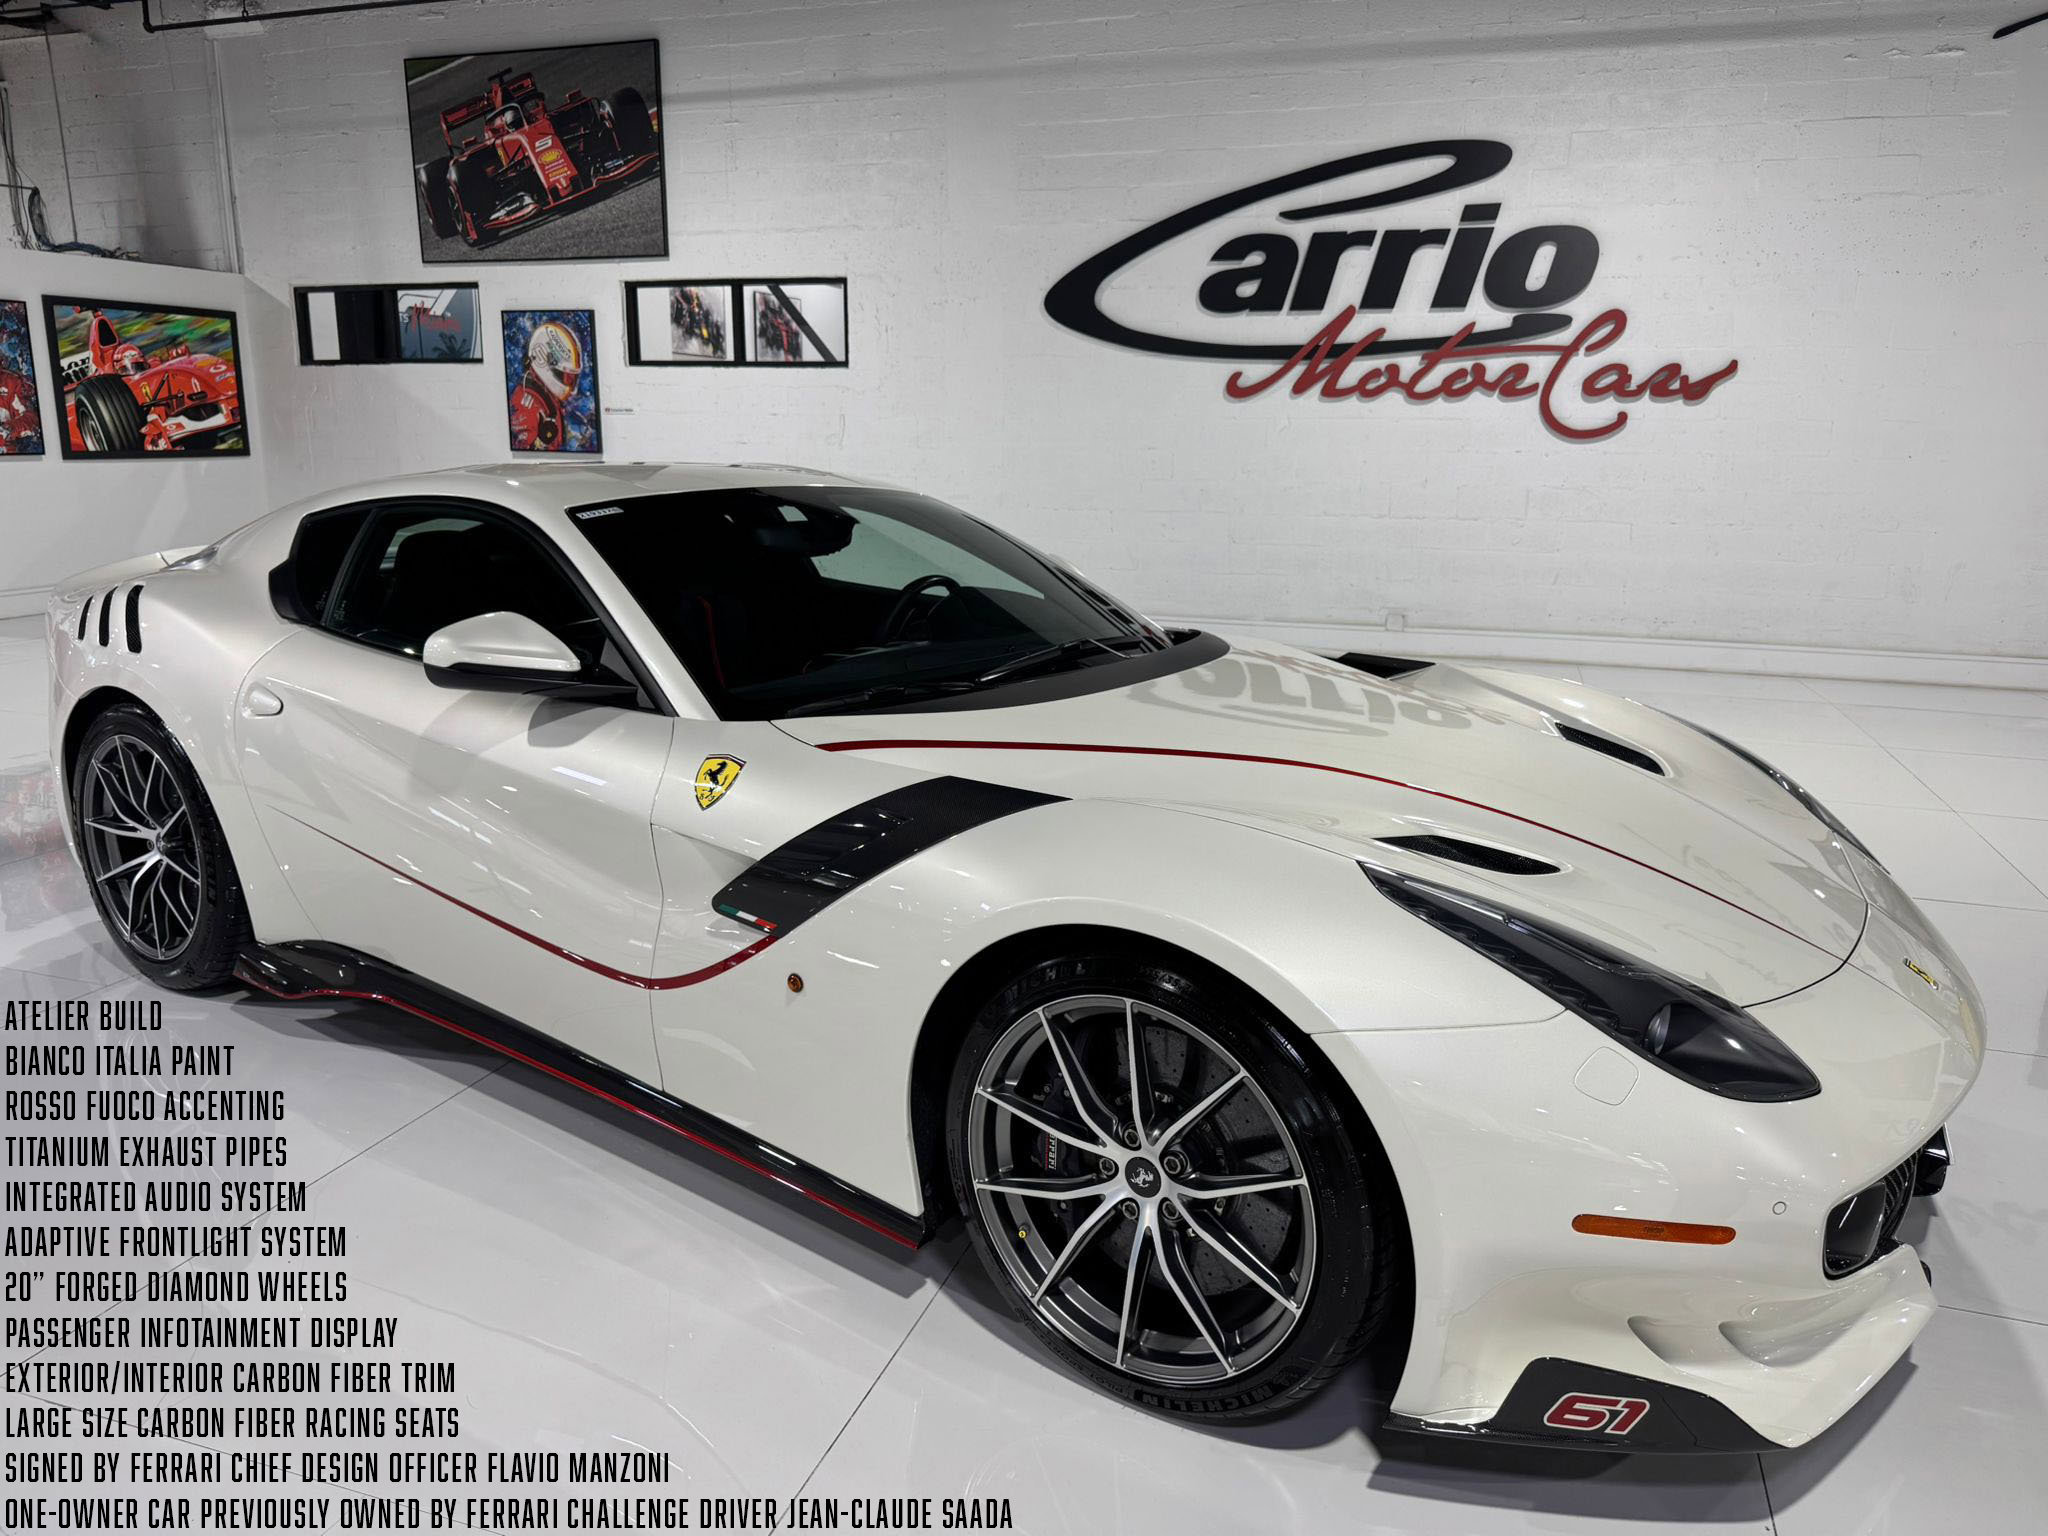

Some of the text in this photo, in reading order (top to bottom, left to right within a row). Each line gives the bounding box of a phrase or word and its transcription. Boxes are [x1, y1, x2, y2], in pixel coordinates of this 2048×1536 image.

[1044, 138, 1601, 360] Carrio
[1139, 1380, 1276, 1412] MICHELIN
[1543, 1391, 1651, 1435] 61
